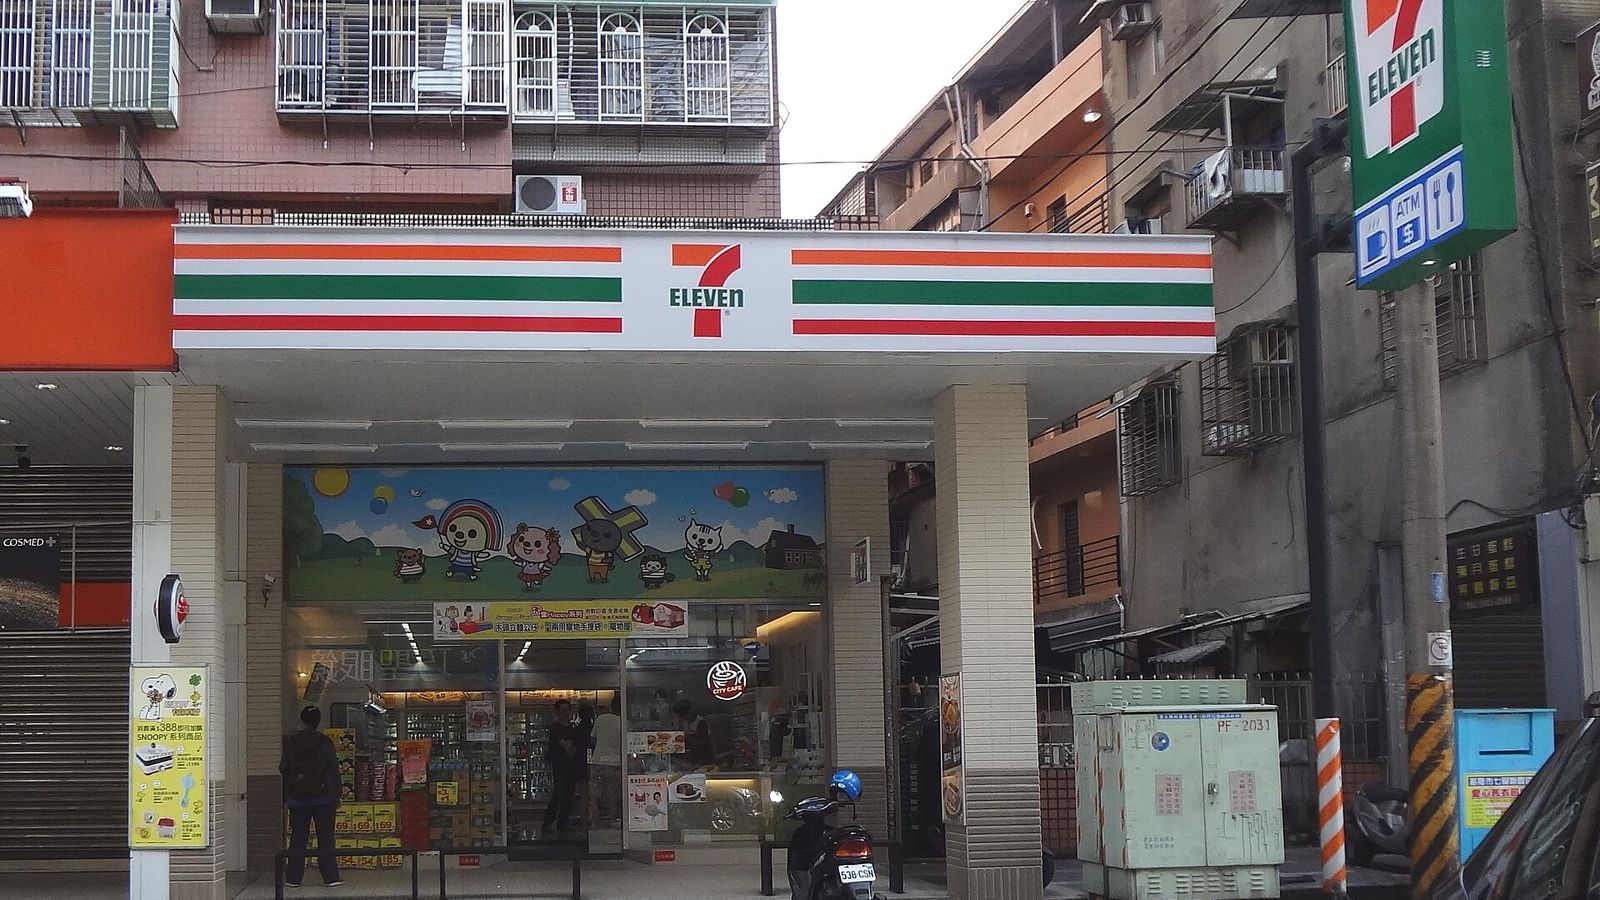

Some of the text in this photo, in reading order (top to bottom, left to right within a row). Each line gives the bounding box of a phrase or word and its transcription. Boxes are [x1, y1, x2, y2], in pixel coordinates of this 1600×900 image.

[1396, 191, 1421, 220] ATM
[669, 288, 744, 307] ELEVEn
[672, 244, 741, 337] 7
[3, 538, 45, 547] COSMED
